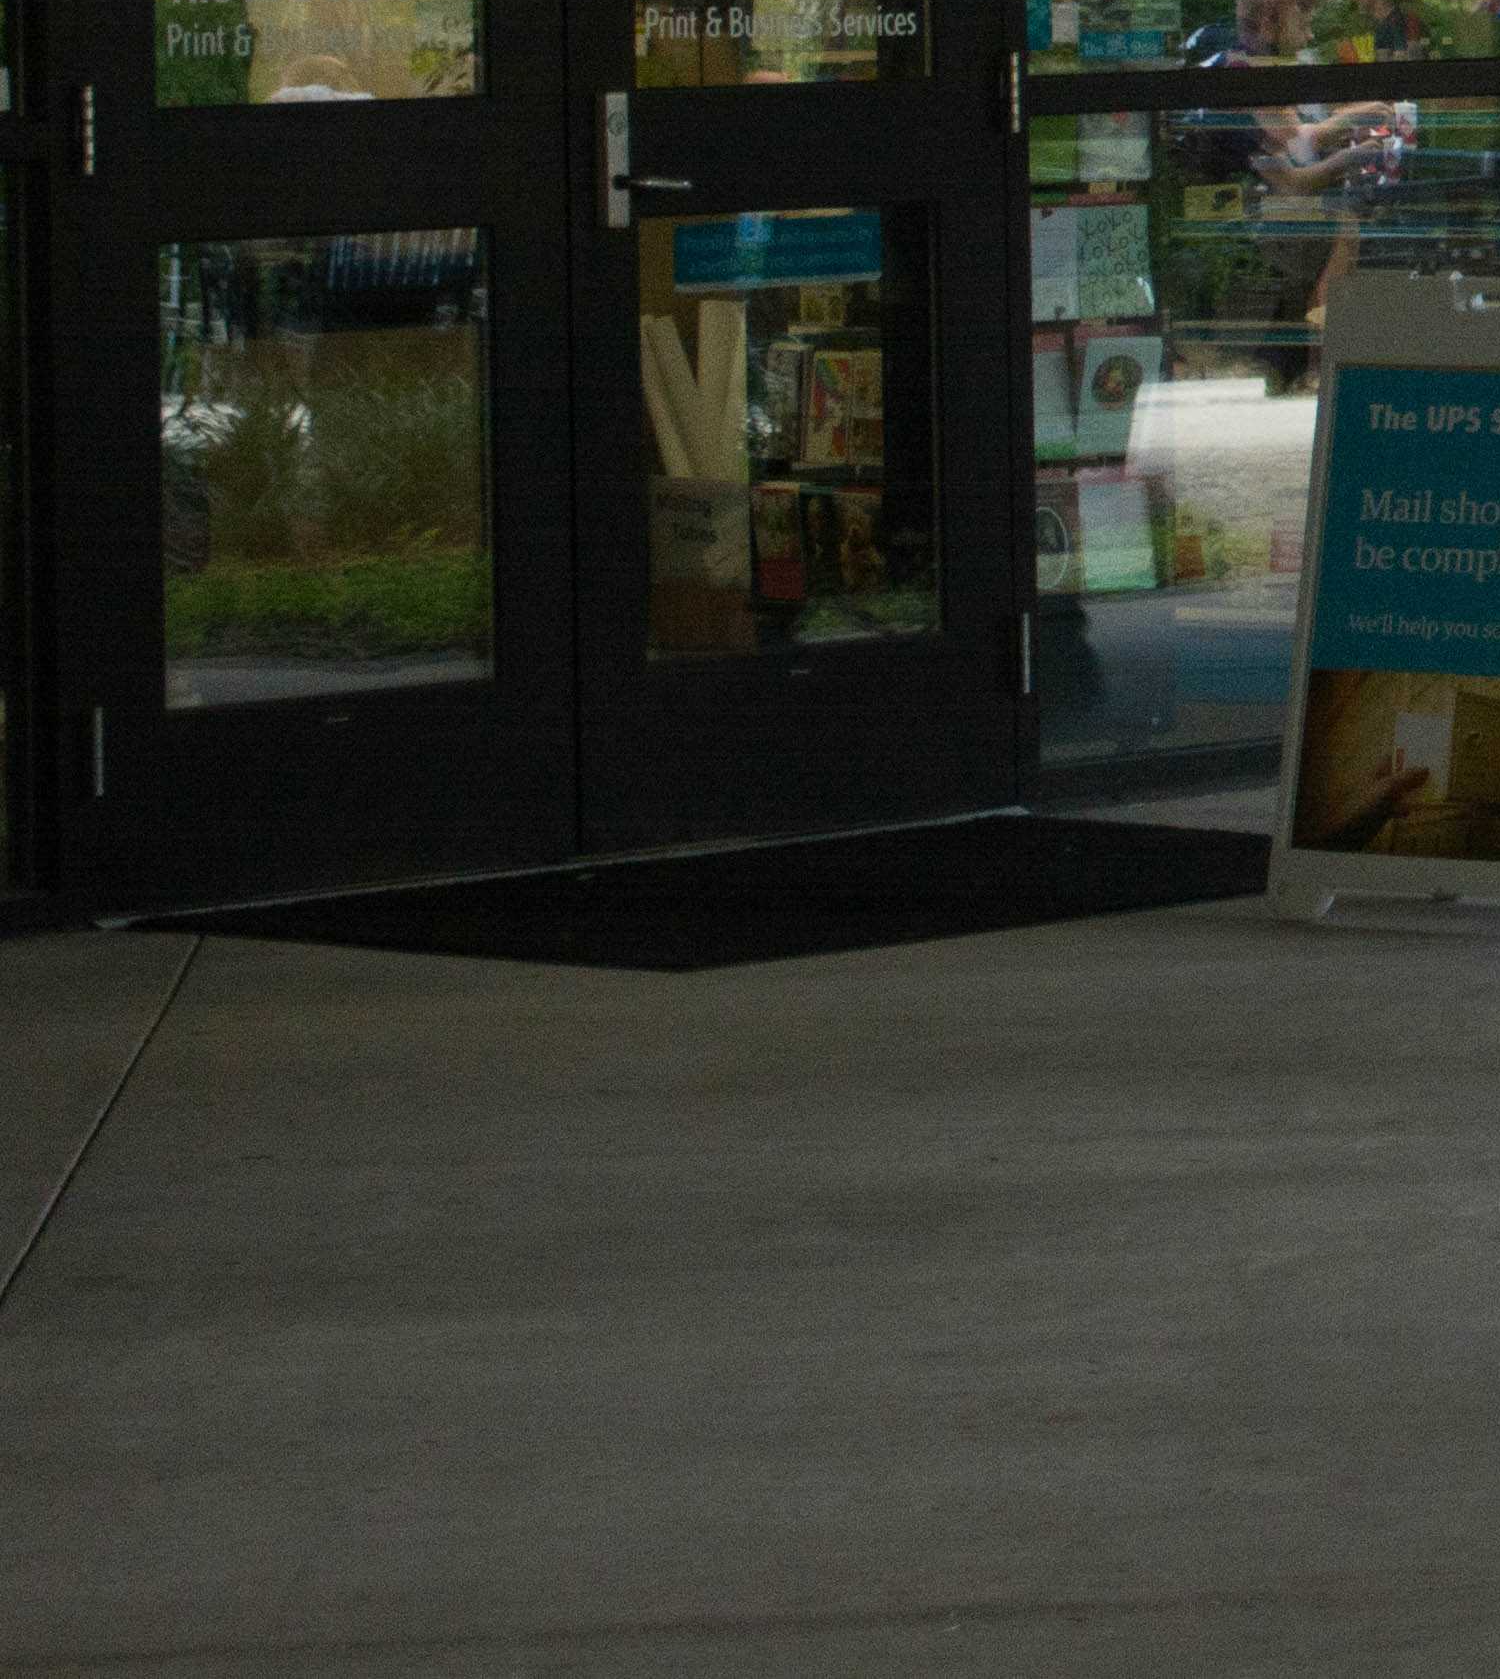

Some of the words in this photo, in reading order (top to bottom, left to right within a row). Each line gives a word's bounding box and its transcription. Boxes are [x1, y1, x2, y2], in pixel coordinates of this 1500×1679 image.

[645, 8, 698, 38] Print
[705, 7, 723, 38] &
[829, 5, 917, 38] Services
[167, 22, 226, 57] Print
[234, 24, 253, 57] &
[1369, 402, 1417, 431] The
[1426, 404, 1482, 434] UPS
[1359, 488, 1434, 524] Mail
[1354, 535, 1396, 571] be
[1348, 613, 1393, 635] We'll
[1398, 614, 1440, 641] help
[1442, 622, 1478, 641] you
